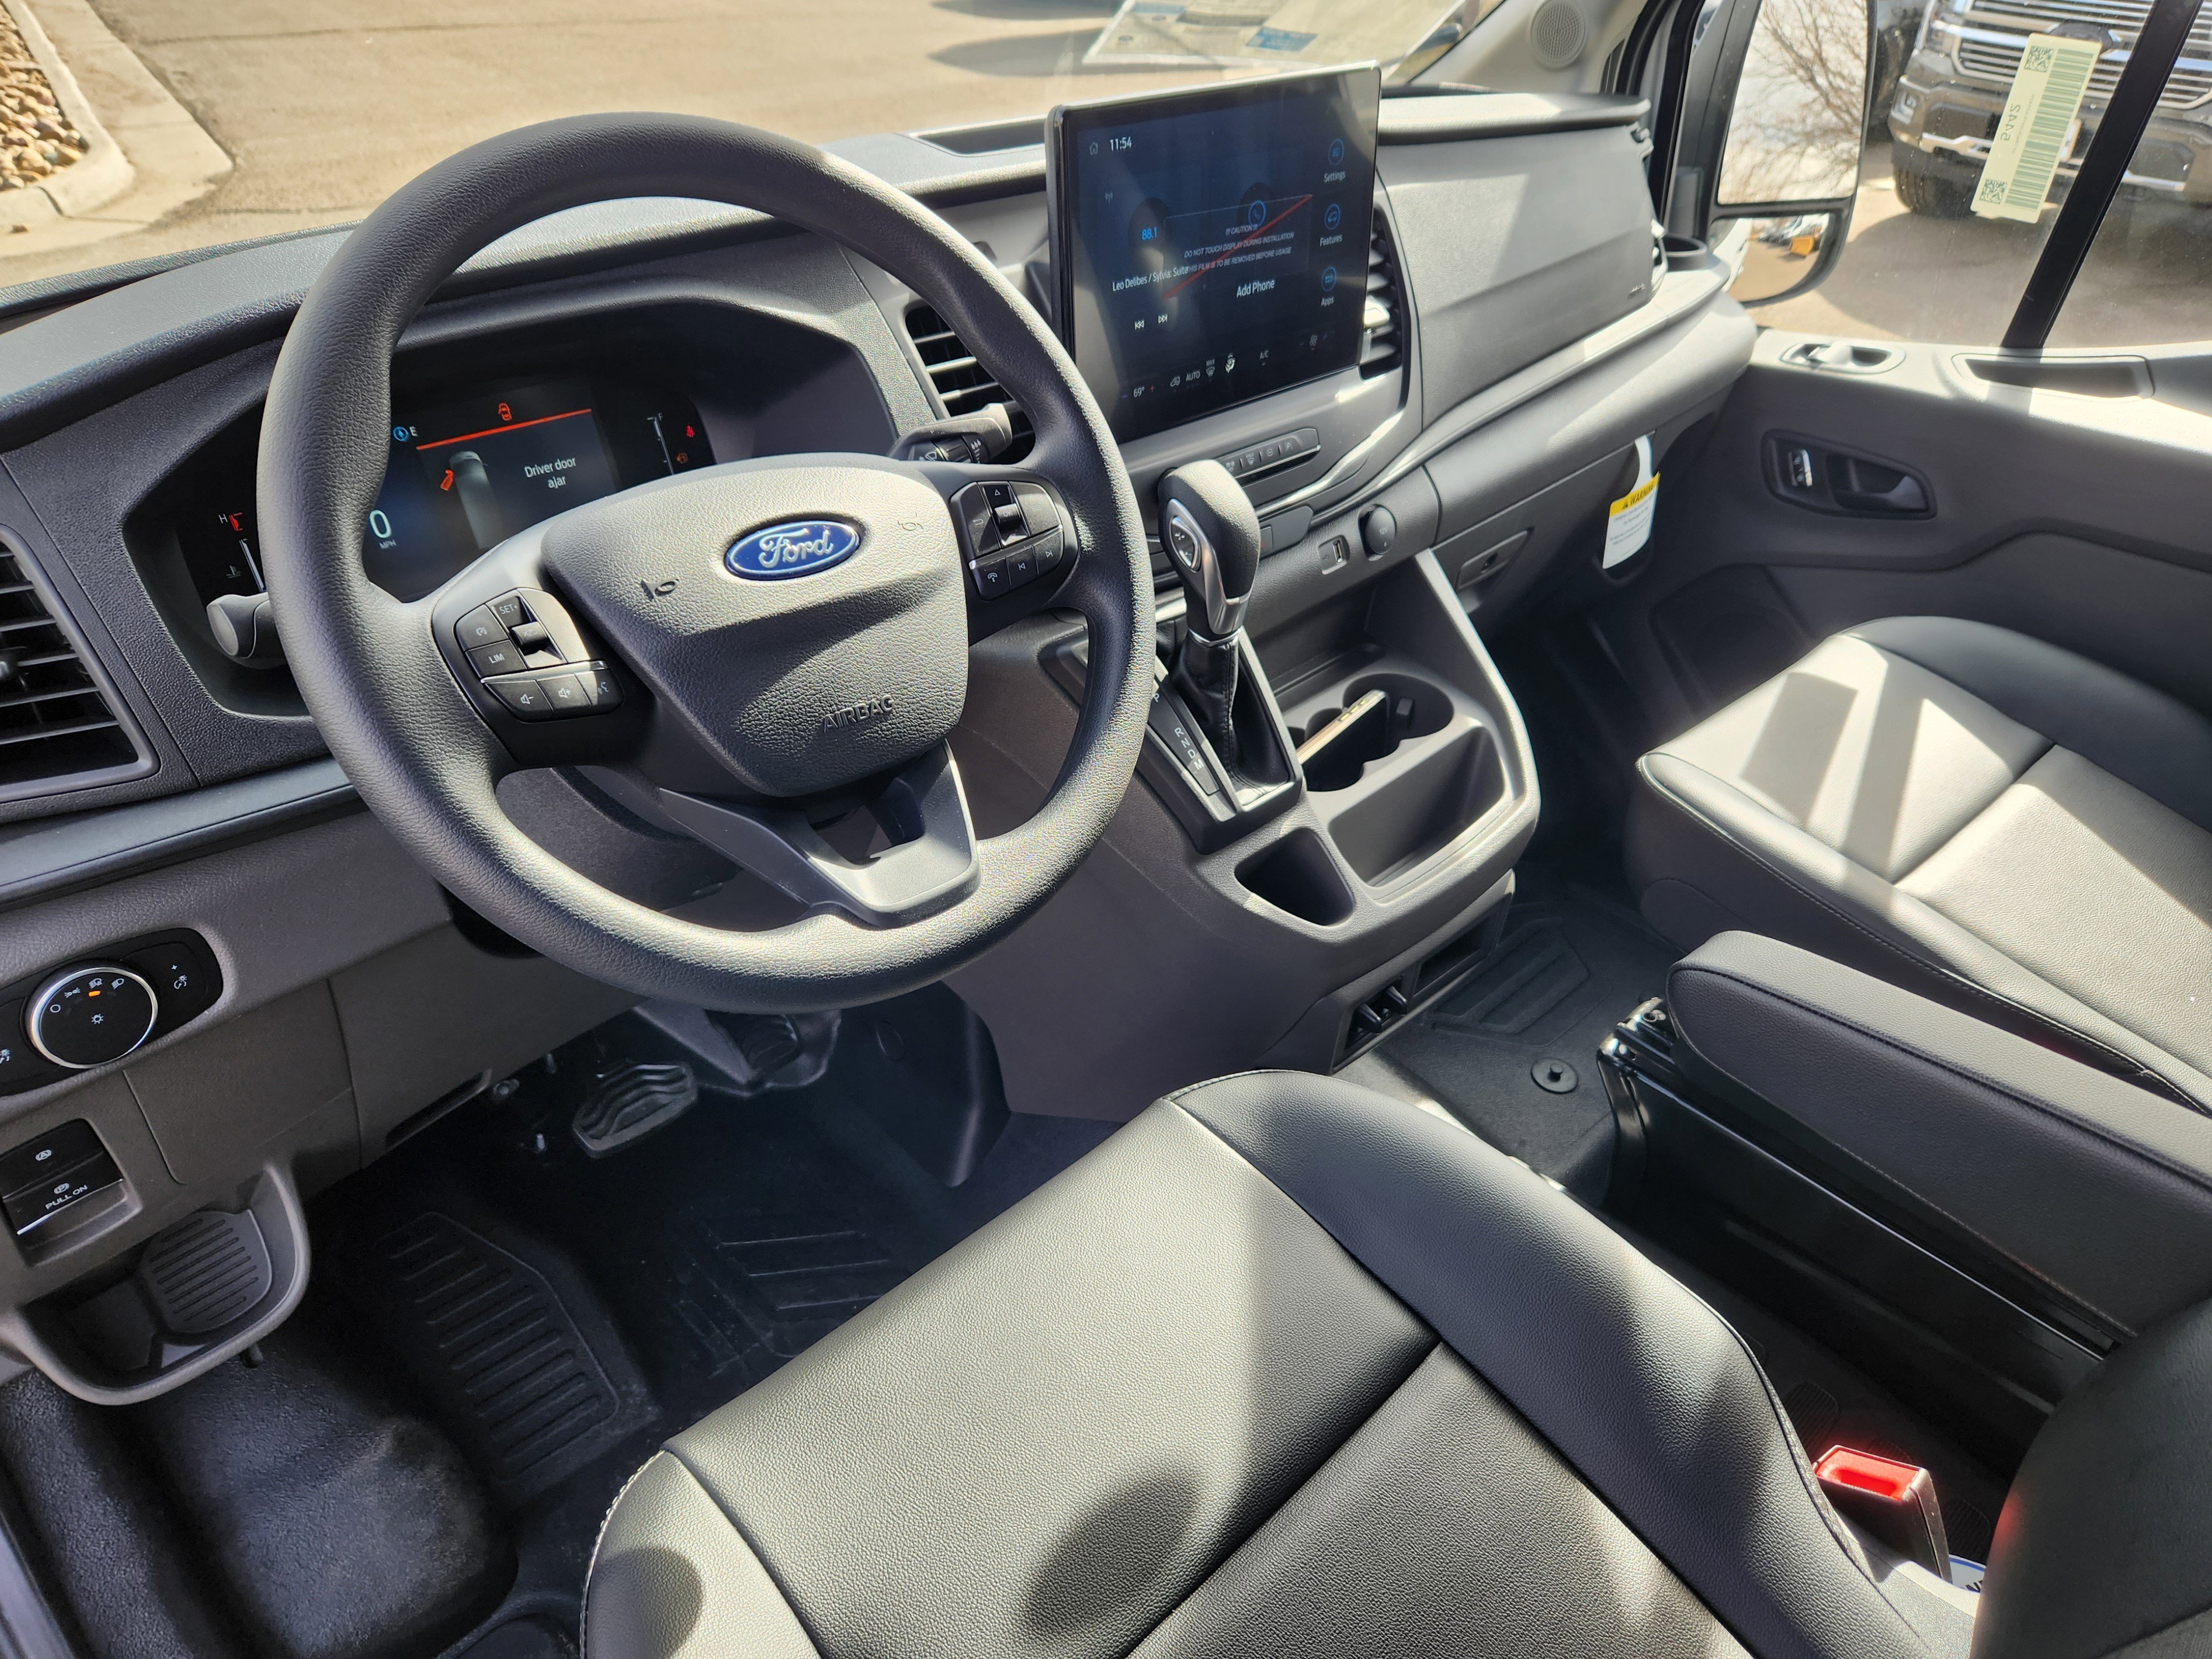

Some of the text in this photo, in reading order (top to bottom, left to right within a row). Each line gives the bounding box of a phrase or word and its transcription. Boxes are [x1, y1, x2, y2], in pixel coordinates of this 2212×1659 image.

[1109, 137, 1132, 152] 11:54
[1324, 171, 1345, 182] Settings
[1142, 227, 1157, 240] 88.1
[1319, 234, 1343, 247] Features
[1193, 248, 1204, 256] NOT
[1205, 245, 1223, 255] TOUCH
[1113, 281, 1124, 291] Leo
[1125, 275, 1147, 288] Delibes
[1152, 270, 1172, 283] Sylvia:
[1237, 279, 1275, 298] Add Phone
[1321, 297, 1335, 307] Apps
[1259, 350, 1270, 360] A/C
[1186, 371, 1201, 382] AUTO
[524, 458, 576, 478] Driver door
[547, 476, 566, 489] ajar
[218, 513, 228, 523] H
[369, 509, 392, 538] 0
[379, 539, 397, 550] MPH
[758, 528, 834, 568] Ford
[499, 604, 519, 615] SET+
[488, 653, 505, 664] LIM
[824, 694, 895, 733] AIRBAG
[1153, 693, 1204, 770] P R N D M
[45, 1184, 88, 1210] PULL ON
